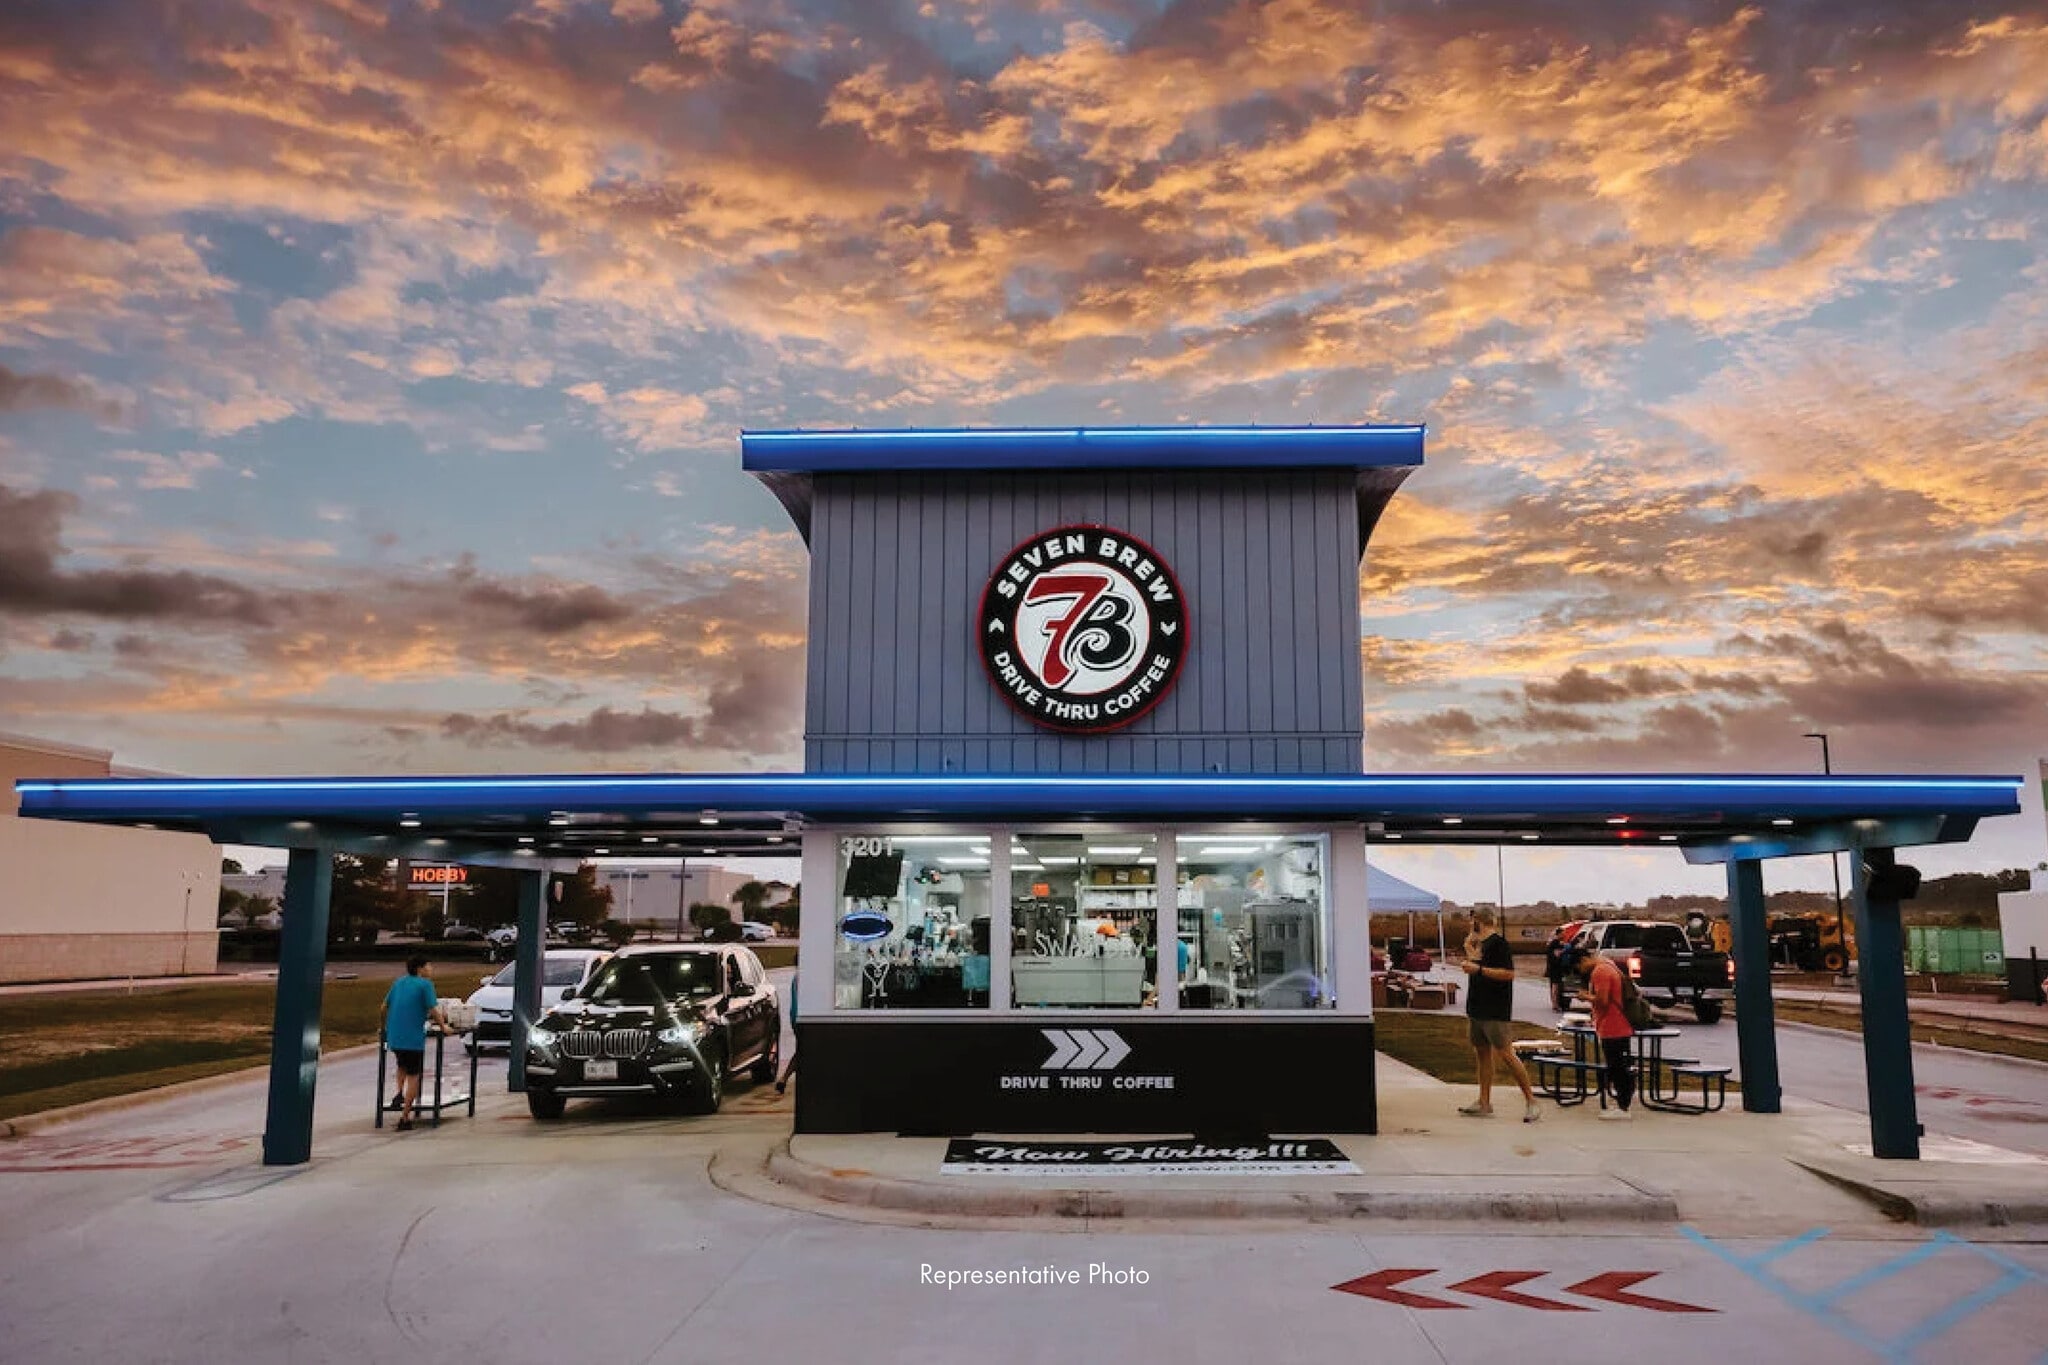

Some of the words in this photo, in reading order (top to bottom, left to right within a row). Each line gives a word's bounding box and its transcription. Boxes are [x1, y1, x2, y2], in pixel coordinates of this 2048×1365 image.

[998, 535, 1085, 598] SEVEN
[1099, 538, 1173, 602] BREW
[994, 651, 1042, 705] DRIVE
[1045, 697, 1098, 720] THRU
[1105, 654, 1171, 714] COFFEE
[841, 837, 893, 858] 3201
[413, 868, 467, 881] HOBBY
[1001, 1076, 1049, 1089] DRIVE
[1060, 1076, 1102, 1089] THRU
[1113, 1076, 1175, 1089] COFFEE
[975, 1146, 1088, 1161] Now
[1102, 1143, 1309, 1161] Hiring!!!
